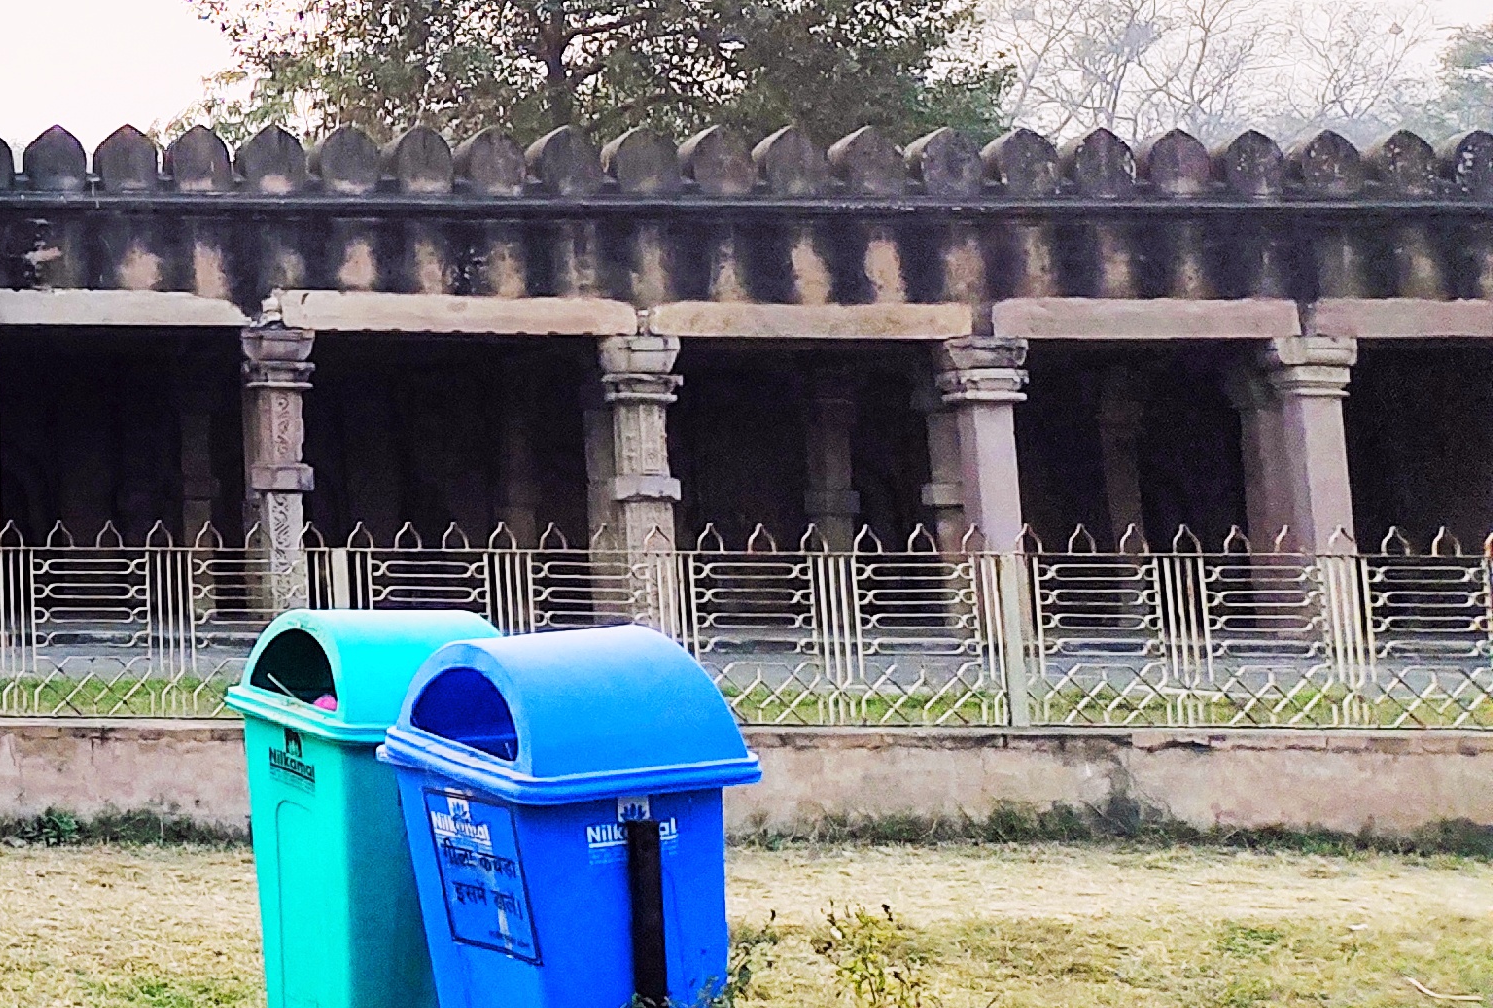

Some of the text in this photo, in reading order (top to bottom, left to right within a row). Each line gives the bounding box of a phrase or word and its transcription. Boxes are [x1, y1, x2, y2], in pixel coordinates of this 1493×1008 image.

[269, 746, 315, 778] Nilkamal
[430, 810, 491, 842] Nilkamal
[586, 817, 677, 844] Nilkal
